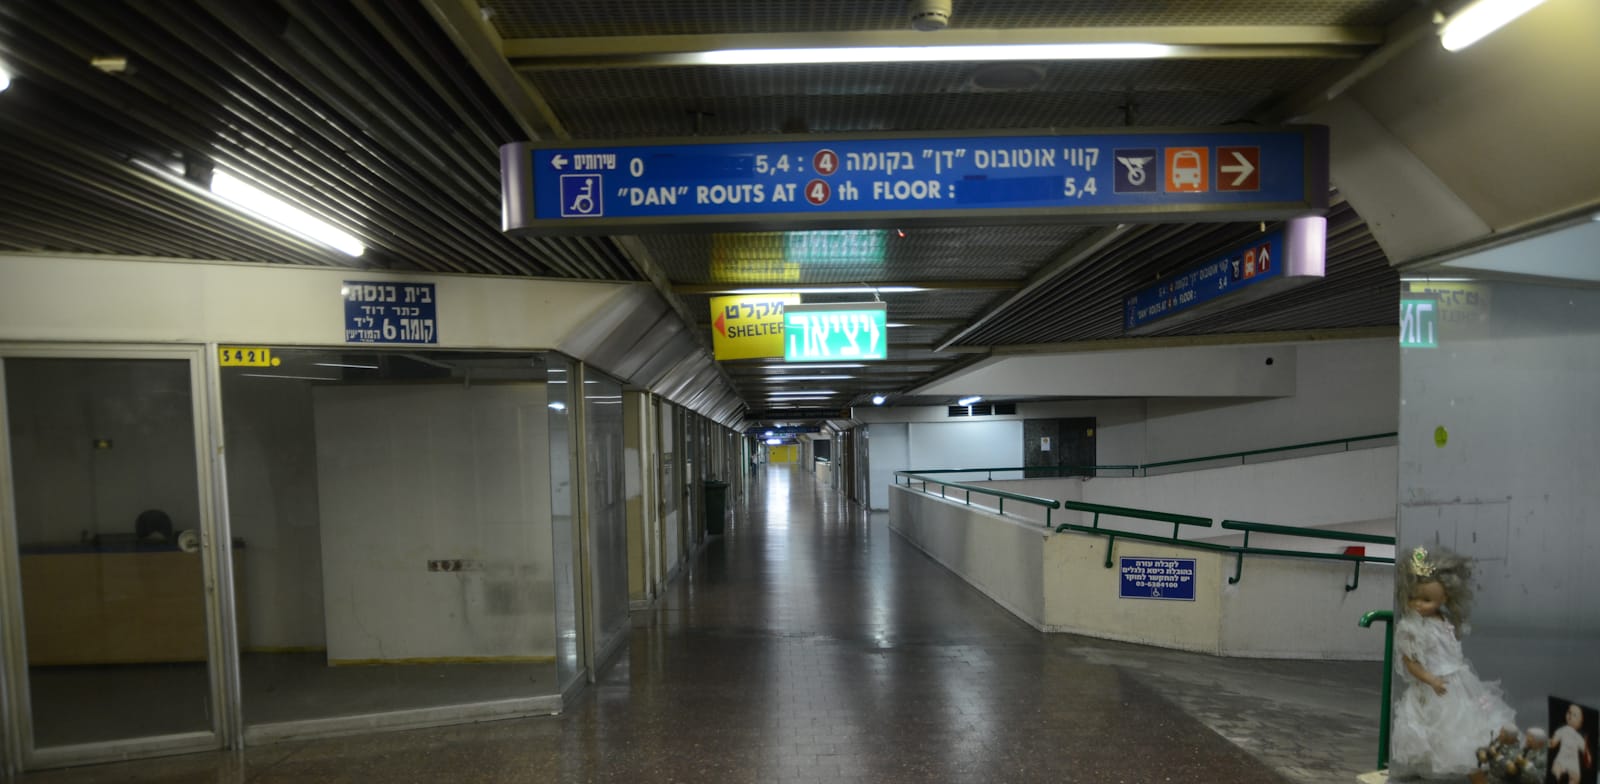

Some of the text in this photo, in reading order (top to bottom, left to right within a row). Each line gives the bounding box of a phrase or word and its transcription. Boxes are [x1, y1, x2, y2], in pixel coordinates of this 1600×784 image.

[573, 154, 616, 170] שירותים
[755, 154, 790, 176] 5,4
[819, 153, 833, 172] 4
[846, 151, 914, 175] בקומה
[974, 148, 1055, 169] אוטובוס
[1064, 148, 1099, 171] קווי
[697, 183, 766, 204] ROUTS
[772, 183, 797, 202] AT
[811, 183, 824, 201] 4
[838, 180, 858, 201] th
[873, 180, 941, 200] FLOOR
[1064, 177, 1097, 199] 5,4
[349, 285, 432, 303] בית כנסת
[360, 305, 419, 316] כתר דוד
[725, 301, 784, 320] מקלט
[353, 316, 374, 328] ליד
[382, 318, 434, 343] קומה 6
[789, 314, 869, 358] יציאה
[223, 350, 265, 362] 5421
